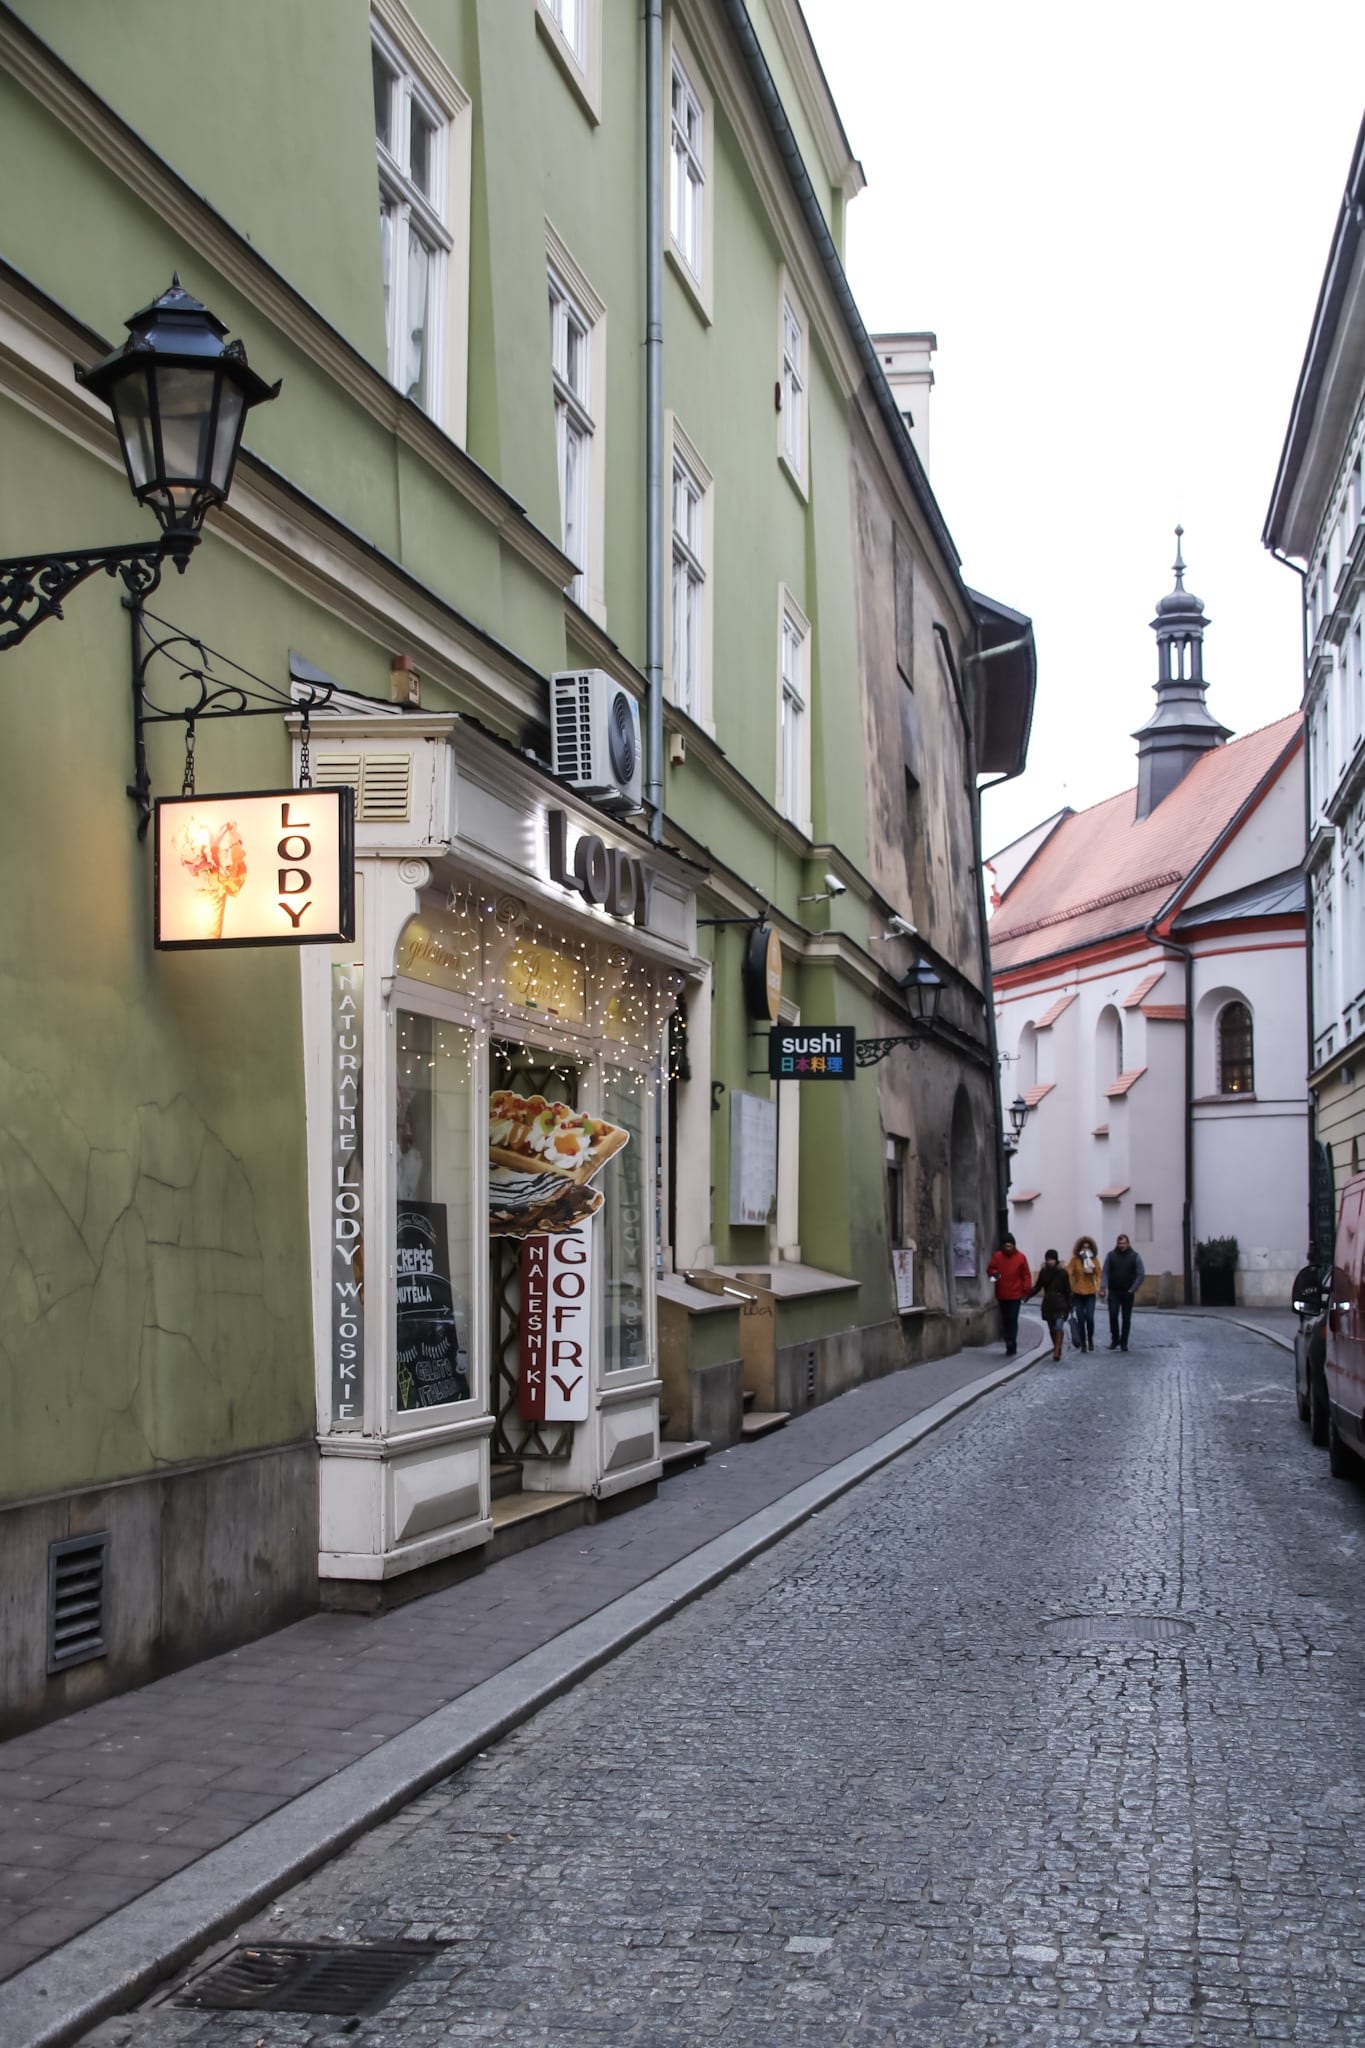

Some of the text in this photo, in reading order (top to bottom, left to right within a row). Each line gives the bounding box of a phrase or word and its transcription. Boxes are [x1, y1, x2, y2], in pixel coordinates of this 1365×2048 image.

[277, 803, 312, 928] LODY
[548, 810, 657, 926] LODY
[781, 1057, 843, 1073] 日本料理
[782, 1033, 841, 1053] sushi
[335, 975, 363, 1420] NATURALNE LODY WŁOSKIE
[396, 1243, 434, 1273] CREPÈS
[526, 1247, 544, 1401] NALEŚNIKI
[550, 1238, 587, 1402] GOFRY
